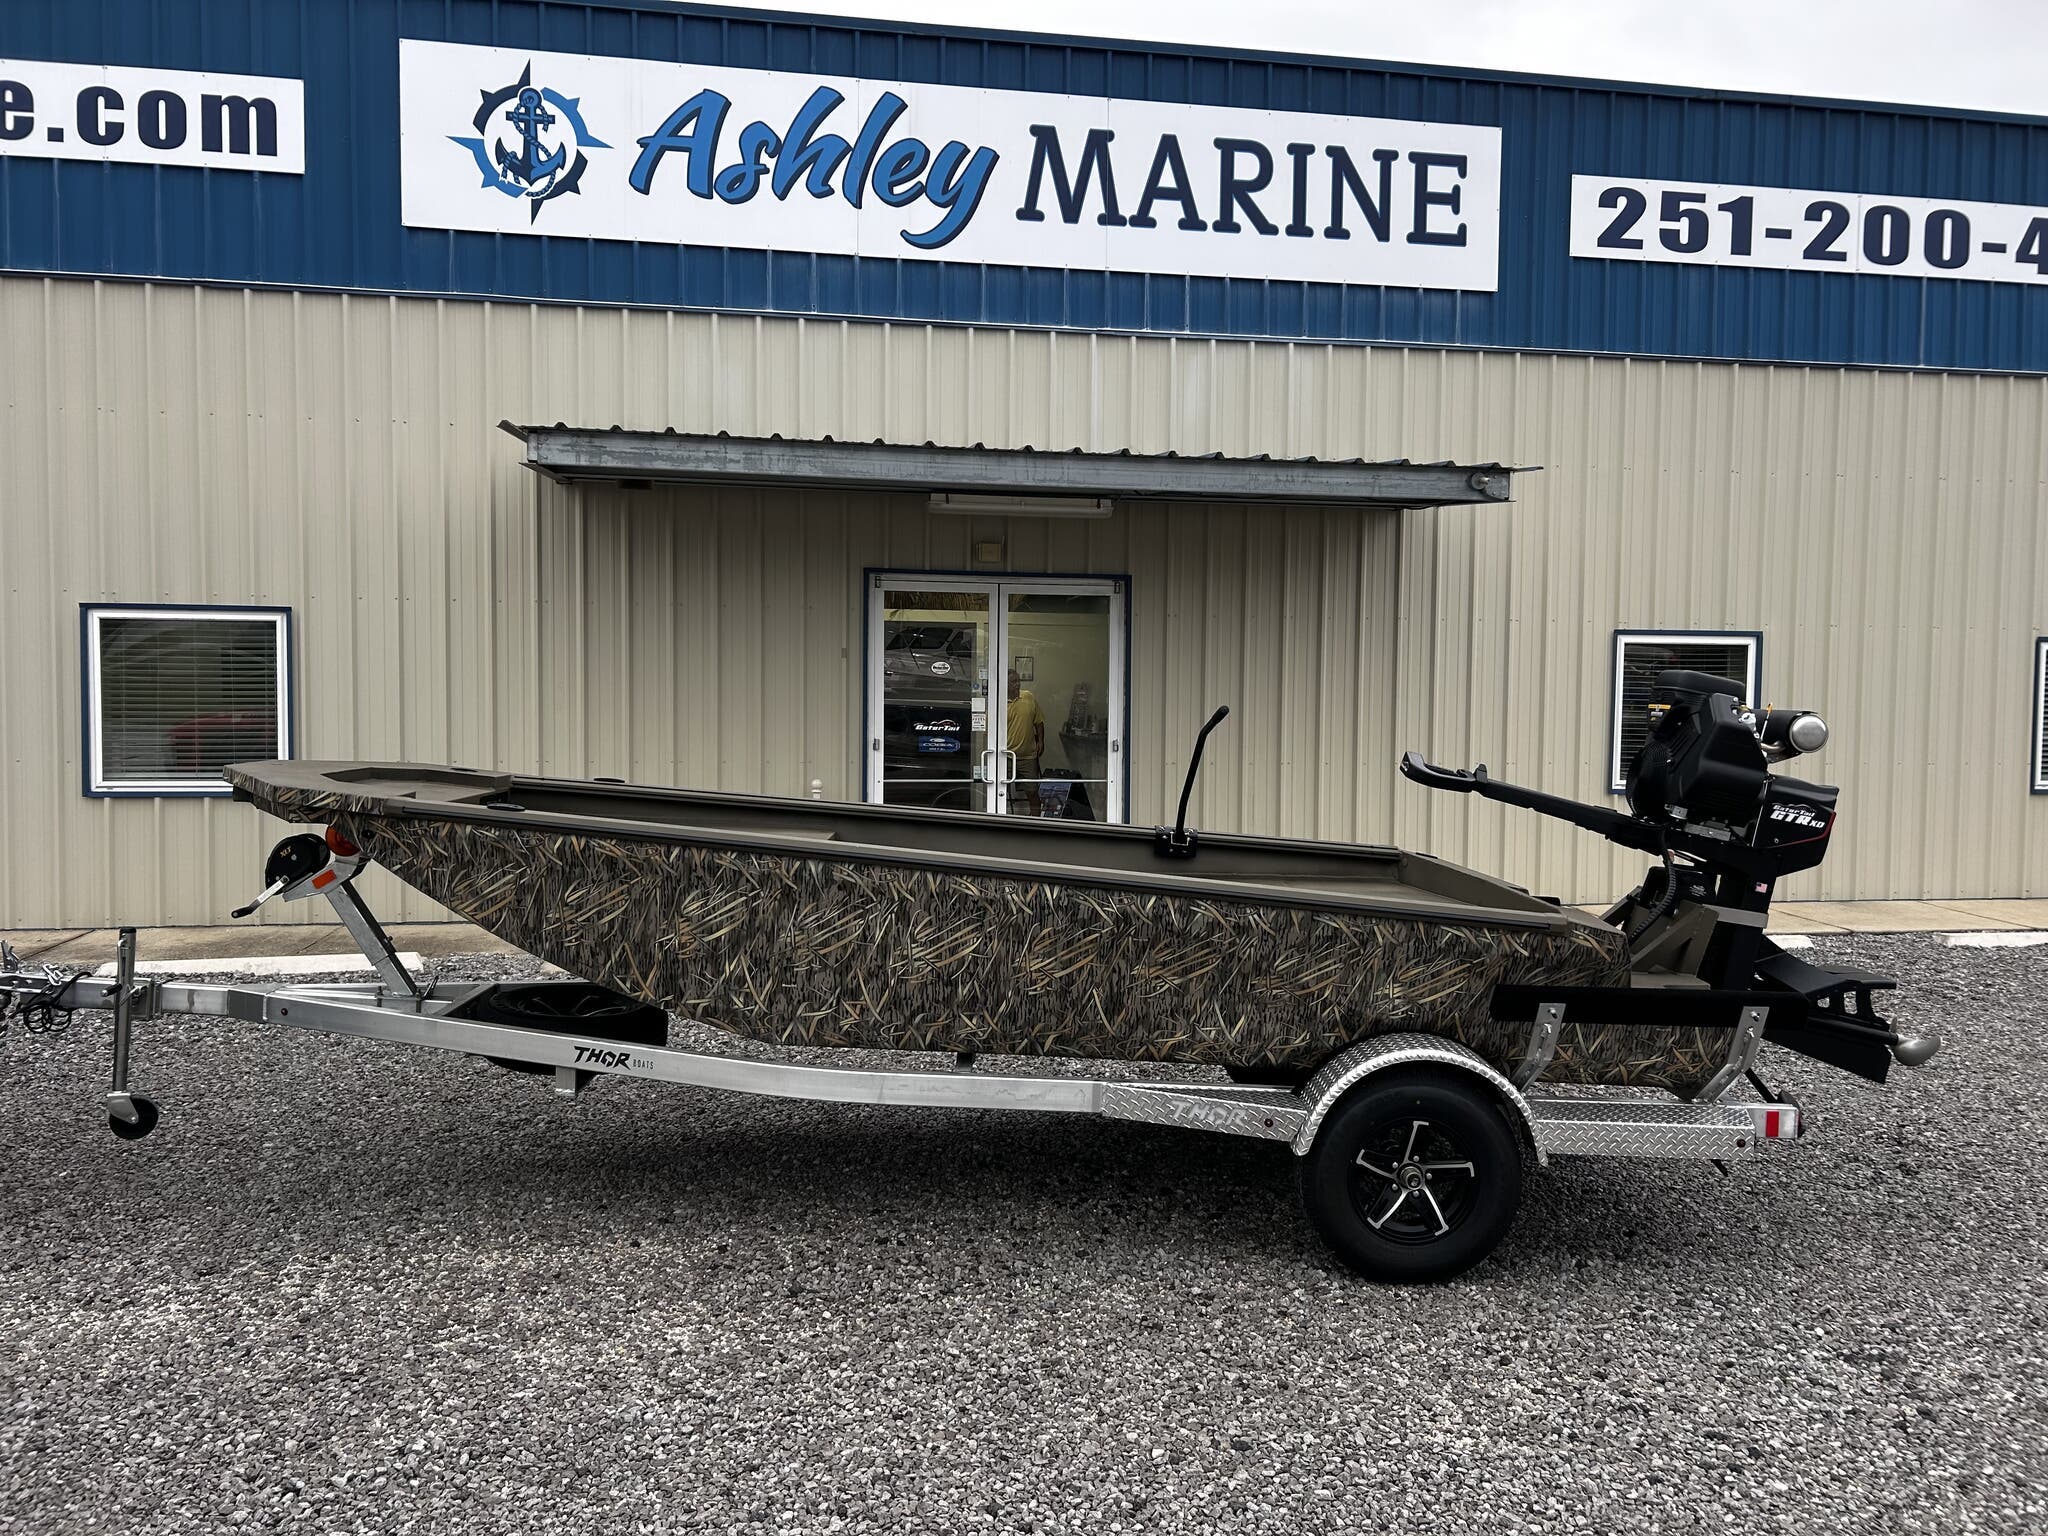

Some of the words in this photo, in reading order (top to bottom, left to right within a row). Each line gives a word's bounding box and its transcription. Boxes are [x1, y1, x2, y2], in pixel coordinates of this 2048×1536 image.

[0, 80, 278, 157] e.com
[628, 85, 1000, 250] Ashley
[1015, 124, 1468, 247] MARINE
[1596, 186, 2048, 275] 251-200-4
[1770, 810, 1812, 826] GTR
[574, 1045, 631, 1070] THOR
[632, 1058, 654, 1070] BOATS
[1170, 1100, 1249, 1127] THOR
